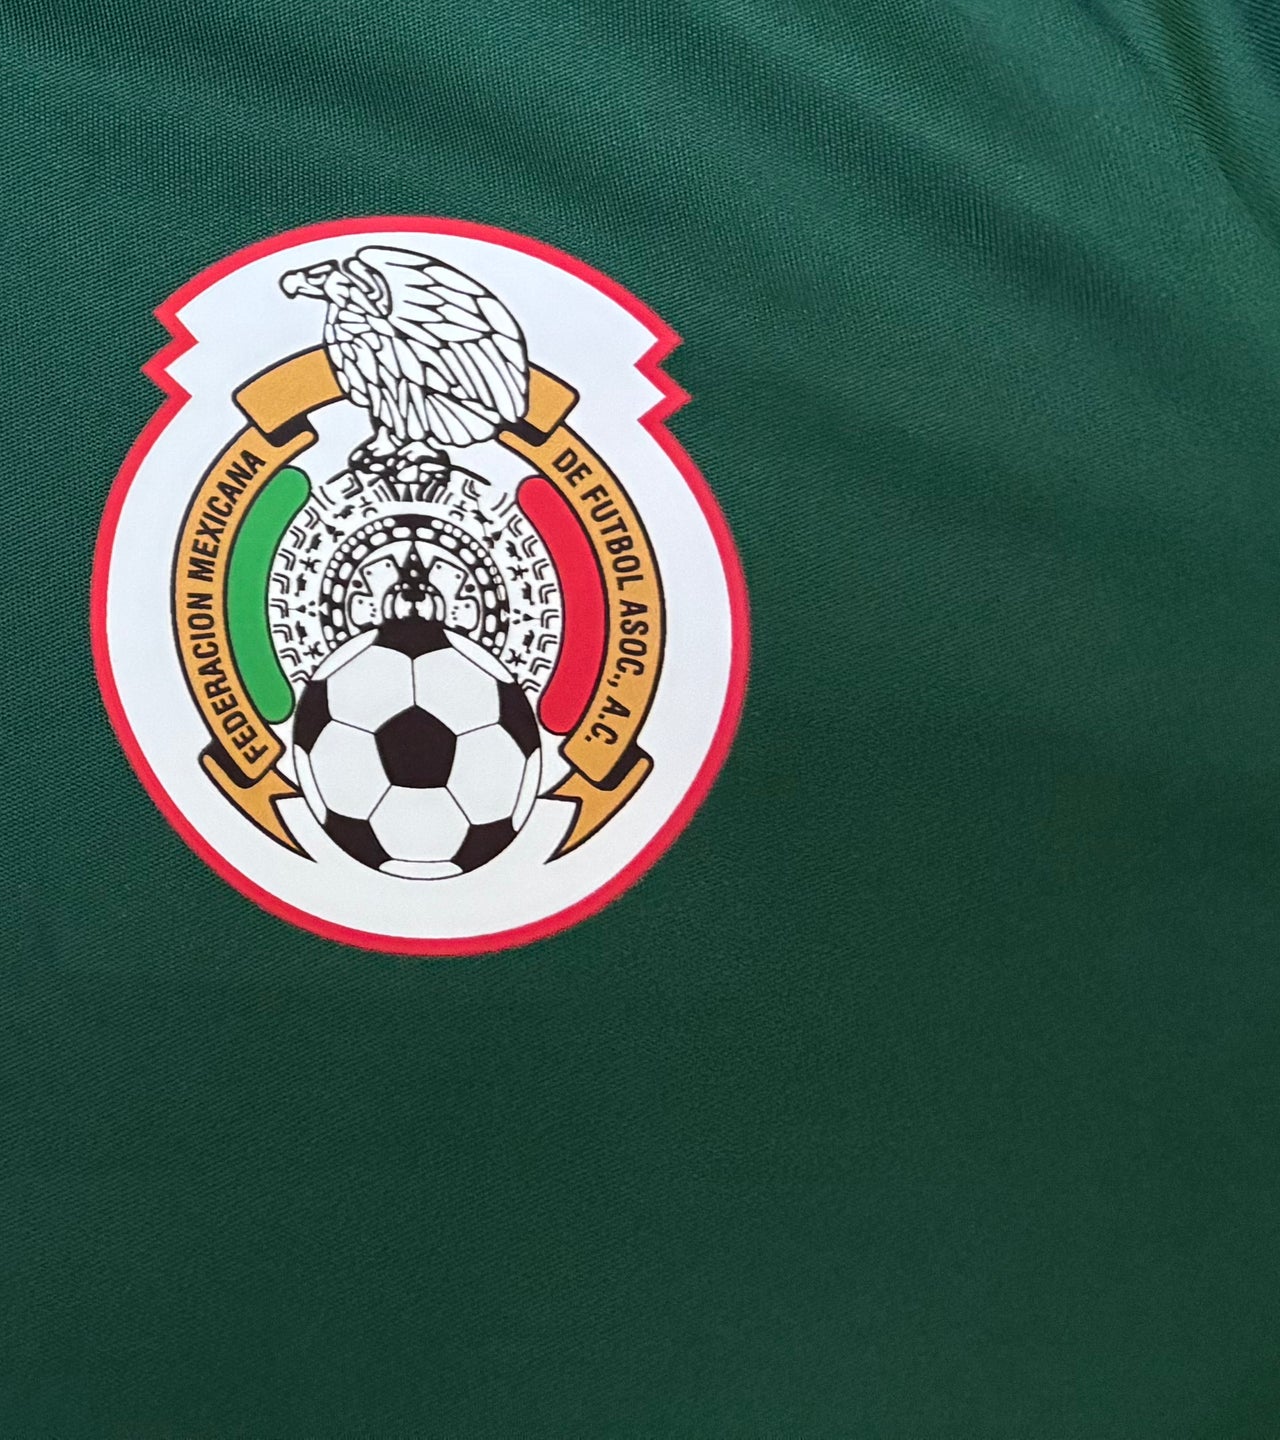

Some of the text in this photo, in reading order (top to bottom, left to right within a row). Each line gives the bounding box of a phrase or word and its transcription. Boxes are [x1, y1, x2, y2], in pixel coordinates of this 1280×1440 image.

[186, 449, 269, 765] FEDERACION MEXICANA
[551, 447, 649, 747] DE FUTBOL ASOC., A.C.
